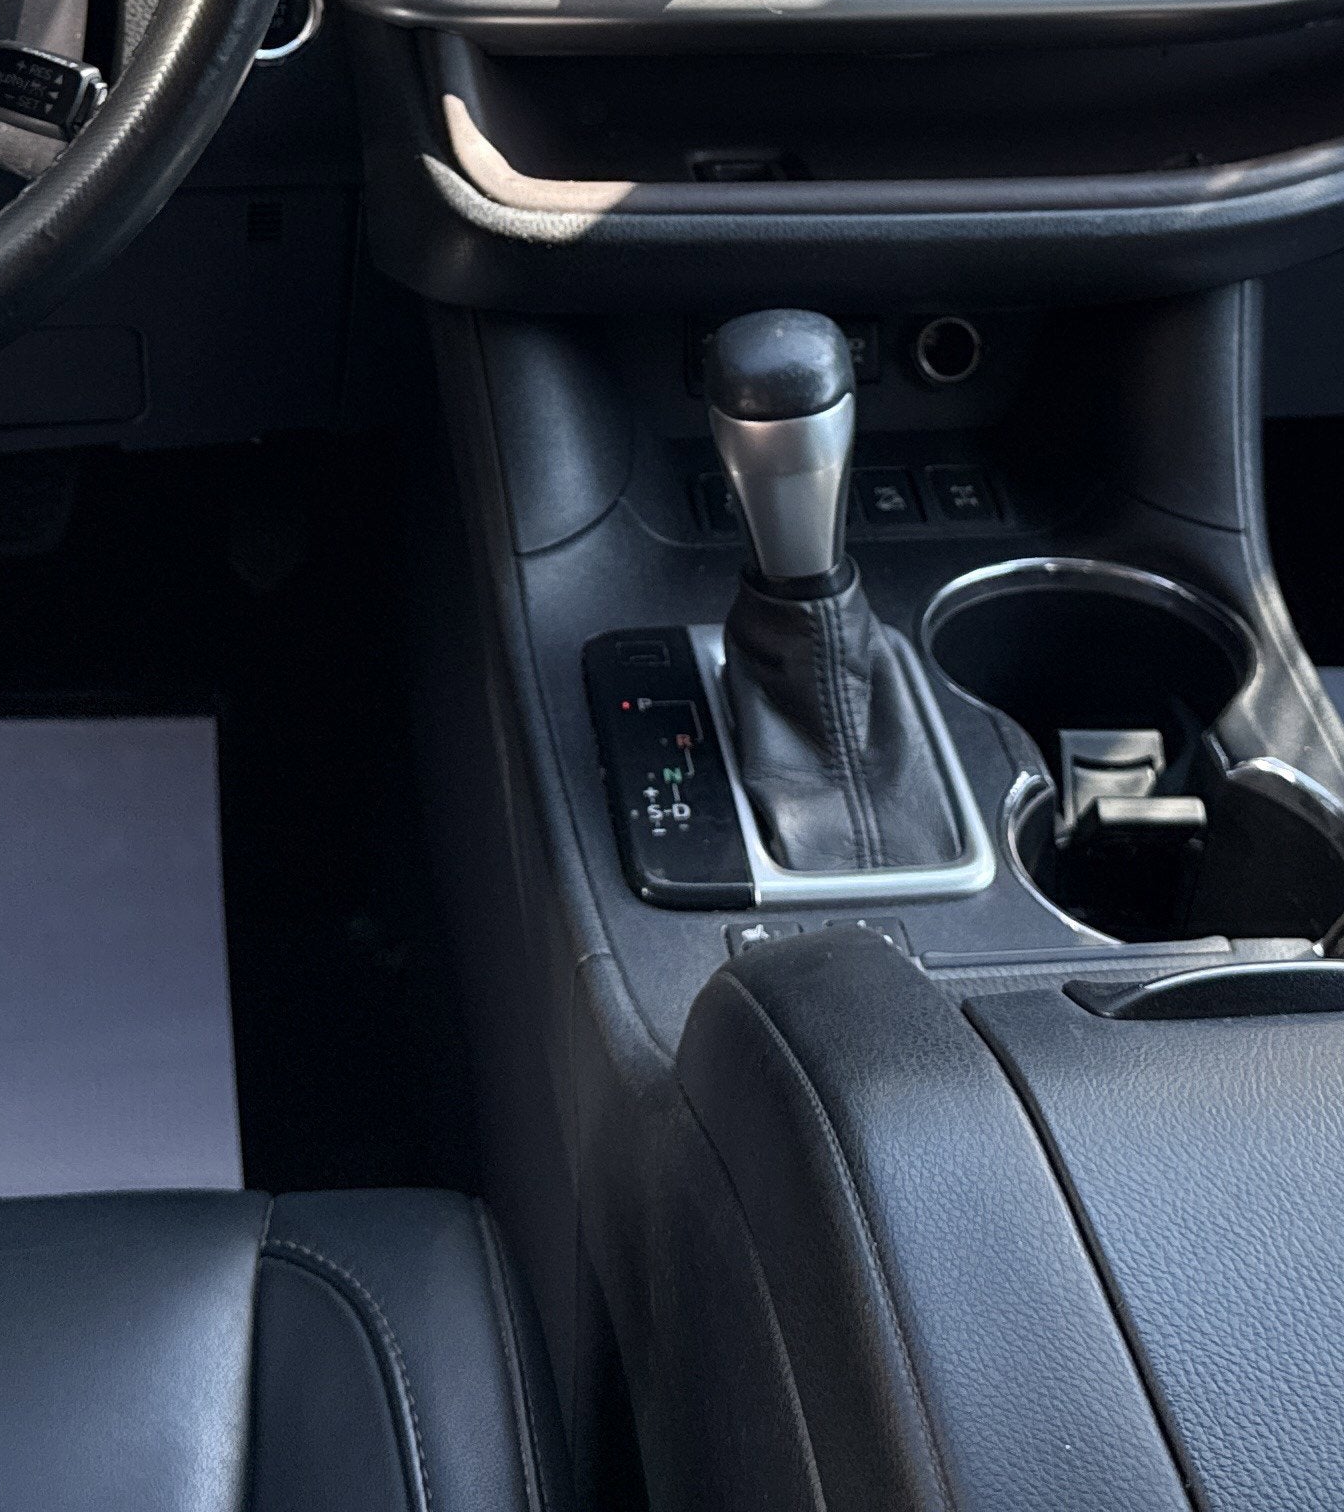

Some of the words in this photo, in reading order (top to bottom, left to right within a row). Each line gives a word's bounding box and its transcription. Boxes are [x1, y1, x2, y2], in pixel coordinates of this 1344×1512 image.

[636, 697, 653, 712] P
[676, 733, 693, 749] R
[663, 767, 683, 785] N
[647, 804, 663, 822] S
[672, 803, 692, 821] D
